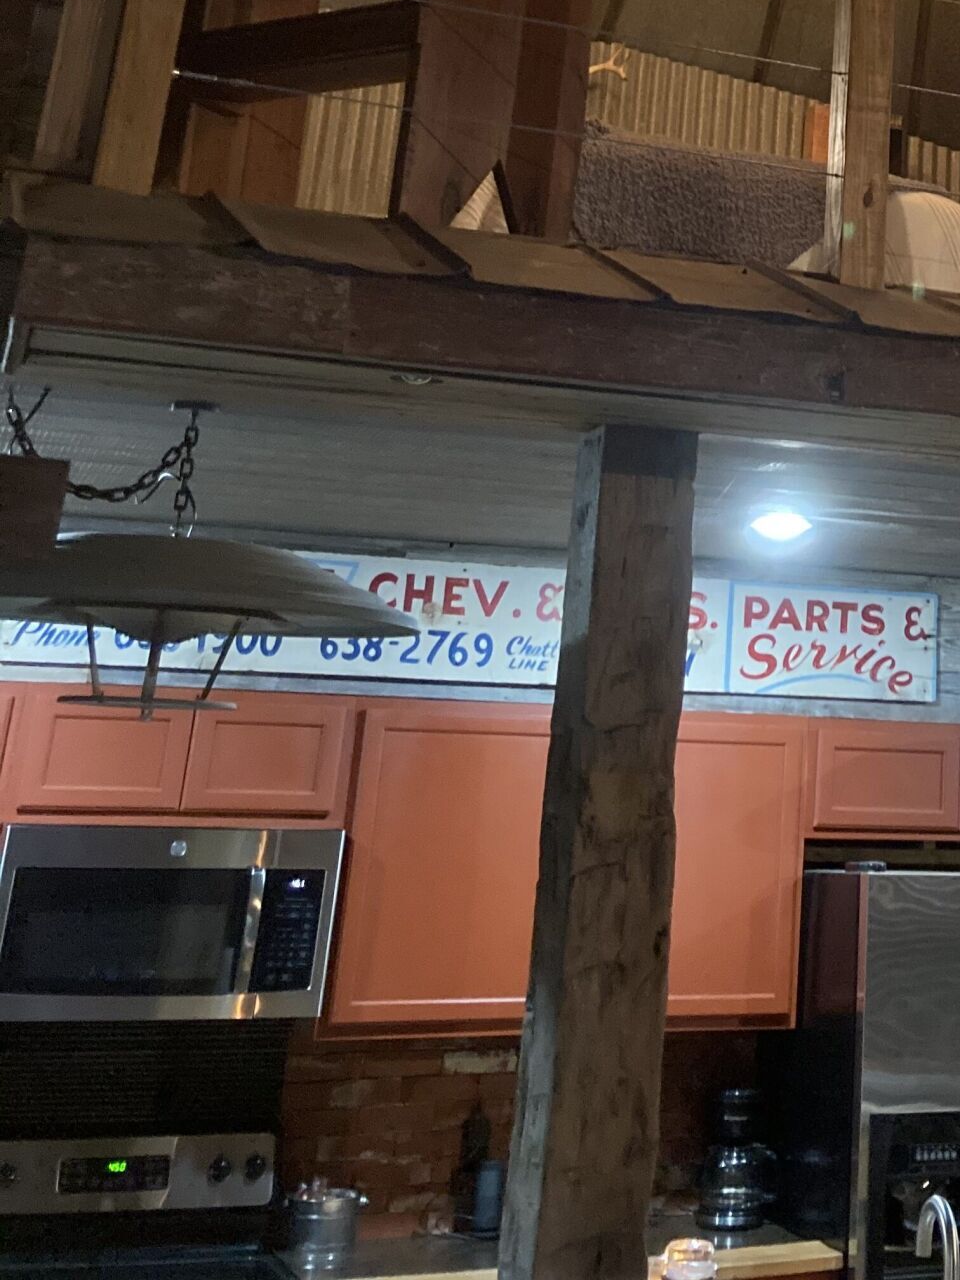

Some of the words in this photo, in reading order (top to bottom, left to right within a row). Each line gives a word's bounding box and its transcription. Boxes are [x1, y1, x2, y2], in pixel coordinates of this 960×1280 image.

[368, 571, 522, 619] CHEV.
[535, 581, 564, 622] &
[742, 595, 886, 636] PARTS
[903, 605, 929, 642] &
[319, 629, 495, 668] 638-2769
[508, 657, 550, 672] LINE
[739, 633, 914, 695] Service
